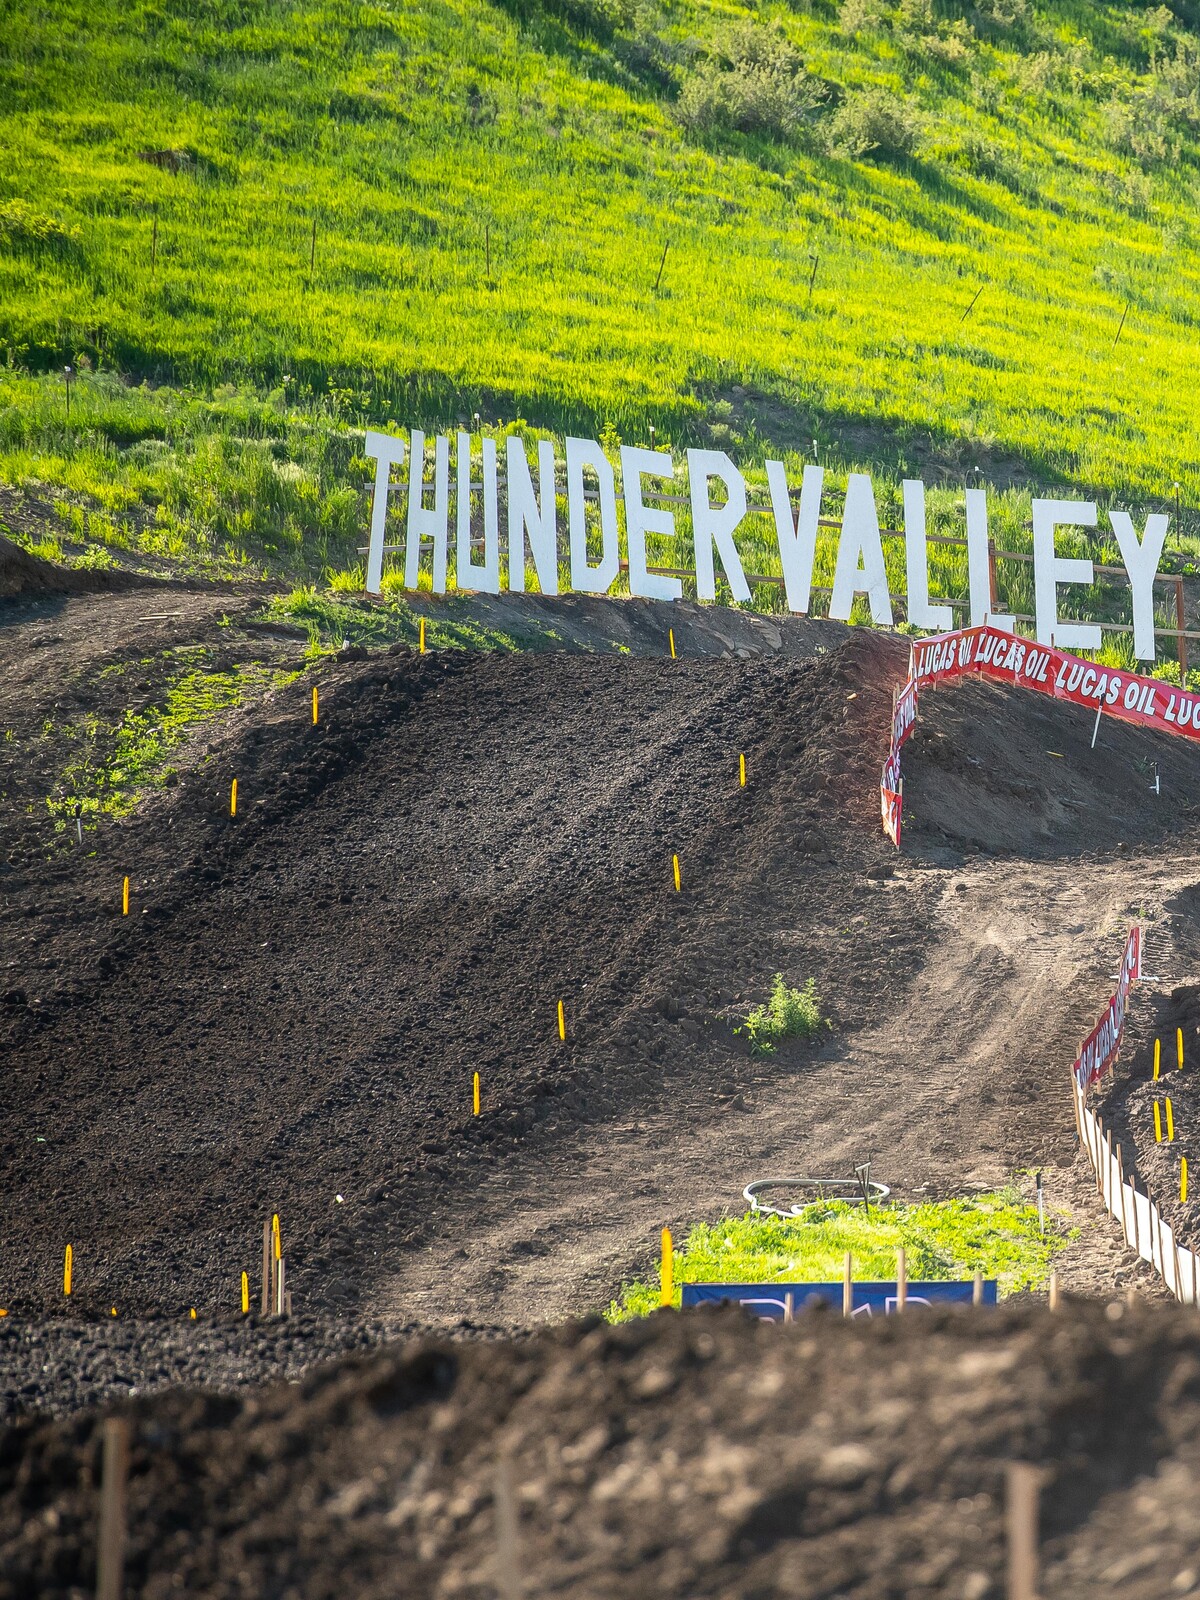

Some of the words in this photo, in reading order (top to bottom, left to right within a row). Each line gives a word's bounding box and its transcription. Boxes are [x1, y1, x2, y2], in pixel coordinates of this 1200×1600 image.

[917, 637, 957, 679] LUCAS
[958, 635, 974, 668] OIL
[974, 633, 1026, 674] LUCAS
[1025, 649, 1050, 682] OIL
[1055, 660, 1122, 705] LUCAS
[1123, 682, 1157, 716] OIL
